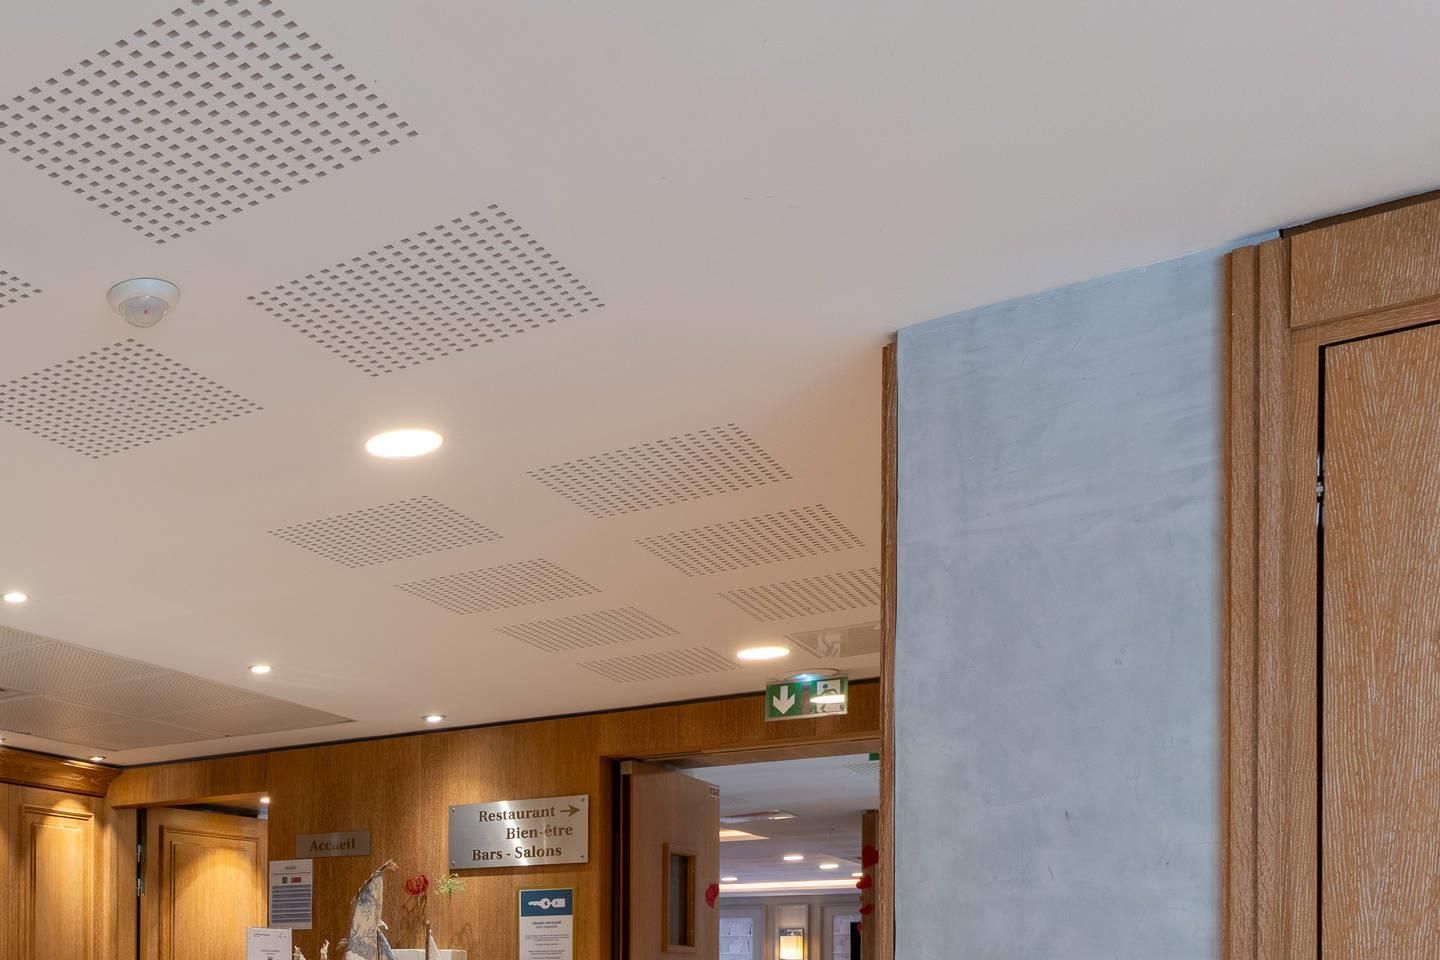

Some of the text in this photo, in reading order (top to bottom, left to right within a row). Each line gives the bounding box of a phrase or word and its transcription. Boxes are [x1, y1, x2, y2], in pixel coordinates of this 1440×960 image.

[479, 806, 556, 822] Restaurant
[506, 824, 574, 840] Bien-être
[310, 838, 356, 852] Accueil
[472, 848, 503, 861] Bars
[514, 845, 562, 859] Salons
